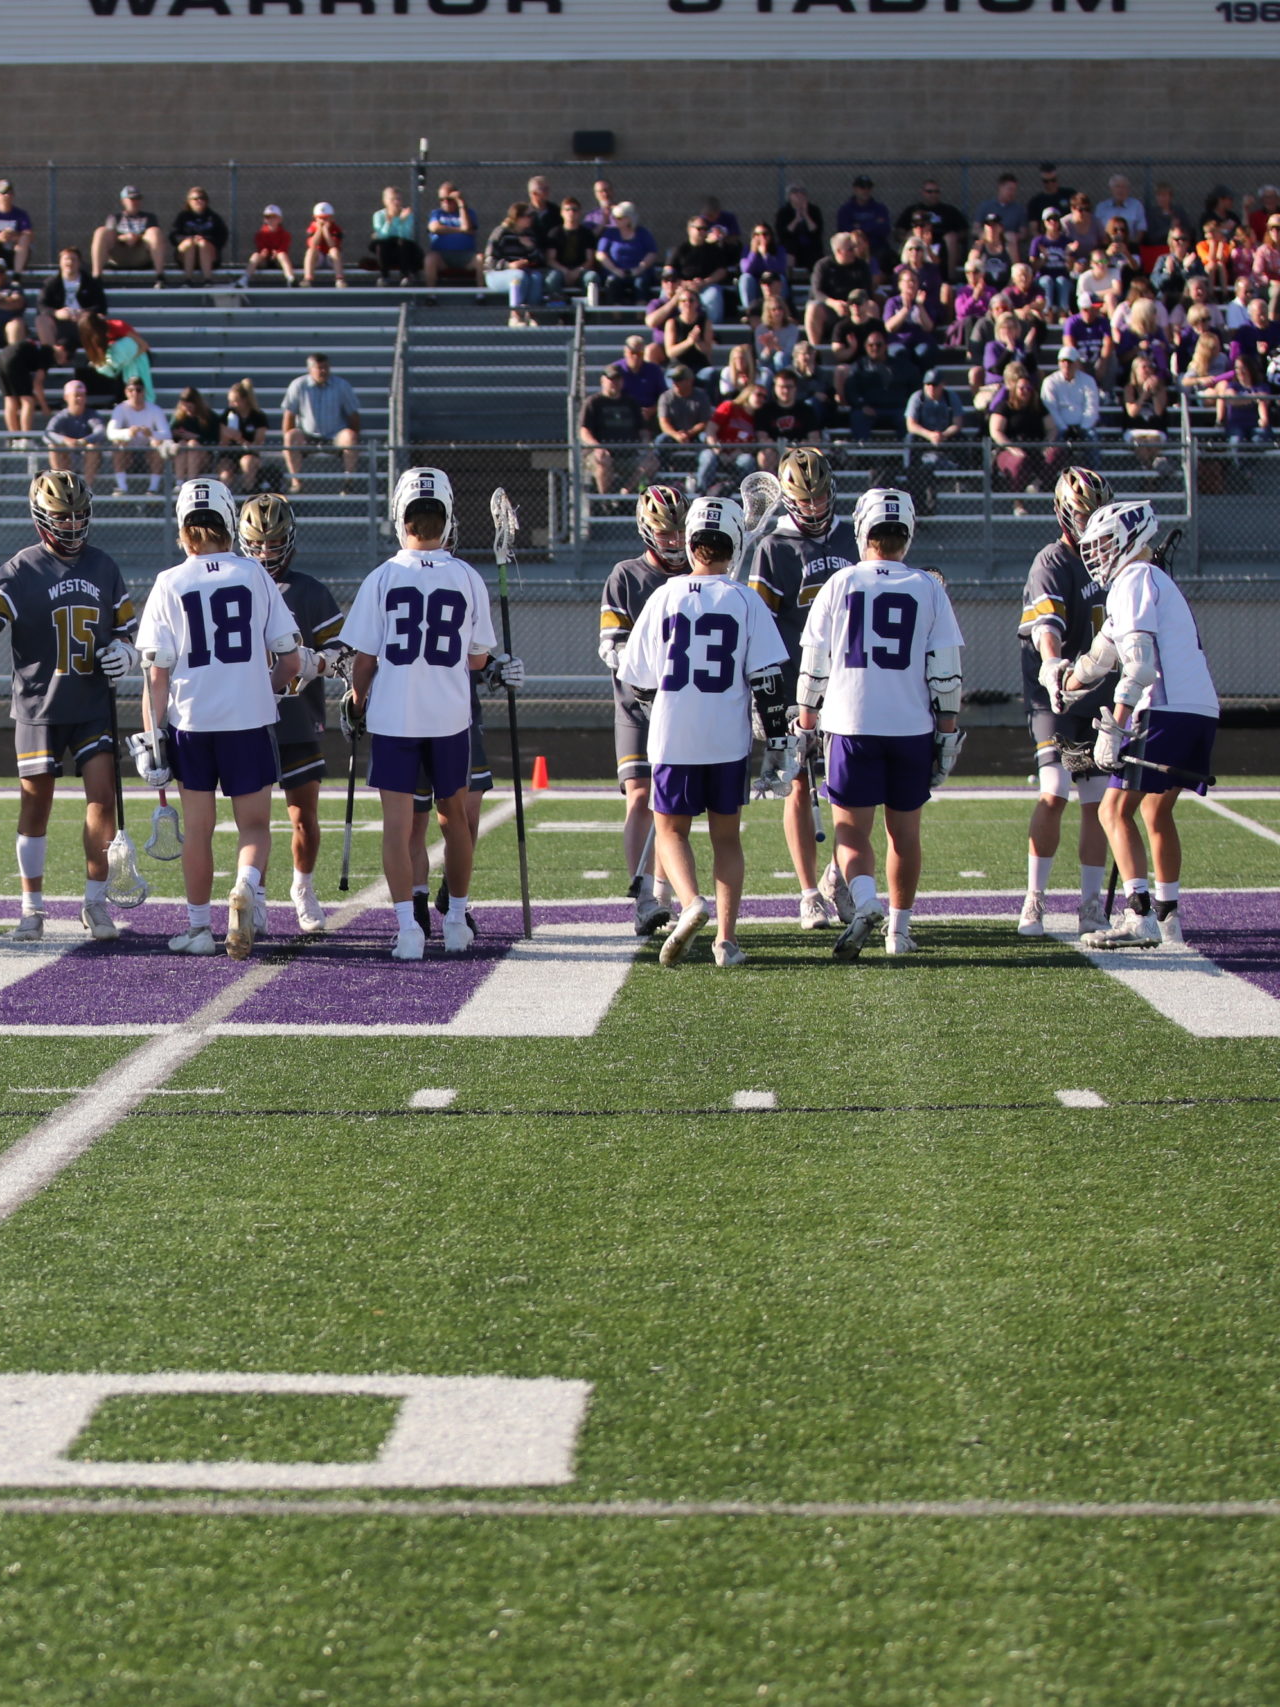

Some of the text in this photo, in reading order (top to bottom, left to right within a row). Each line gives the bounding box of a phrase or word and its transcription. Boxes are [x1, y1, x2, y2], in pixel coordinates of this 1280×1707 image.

[1120, 507, 1145, 532] W
[48, 578, 101, 602] WESTSIDE
[802, 556, 854, 578] WESTSID
[51, 605, 100, 675] 15
[180, 585, 252, 668] 18
[385, 586, 467, 668] 38
[660, 612, 739, 694] 33
[844, 591, 918, 670] 19
